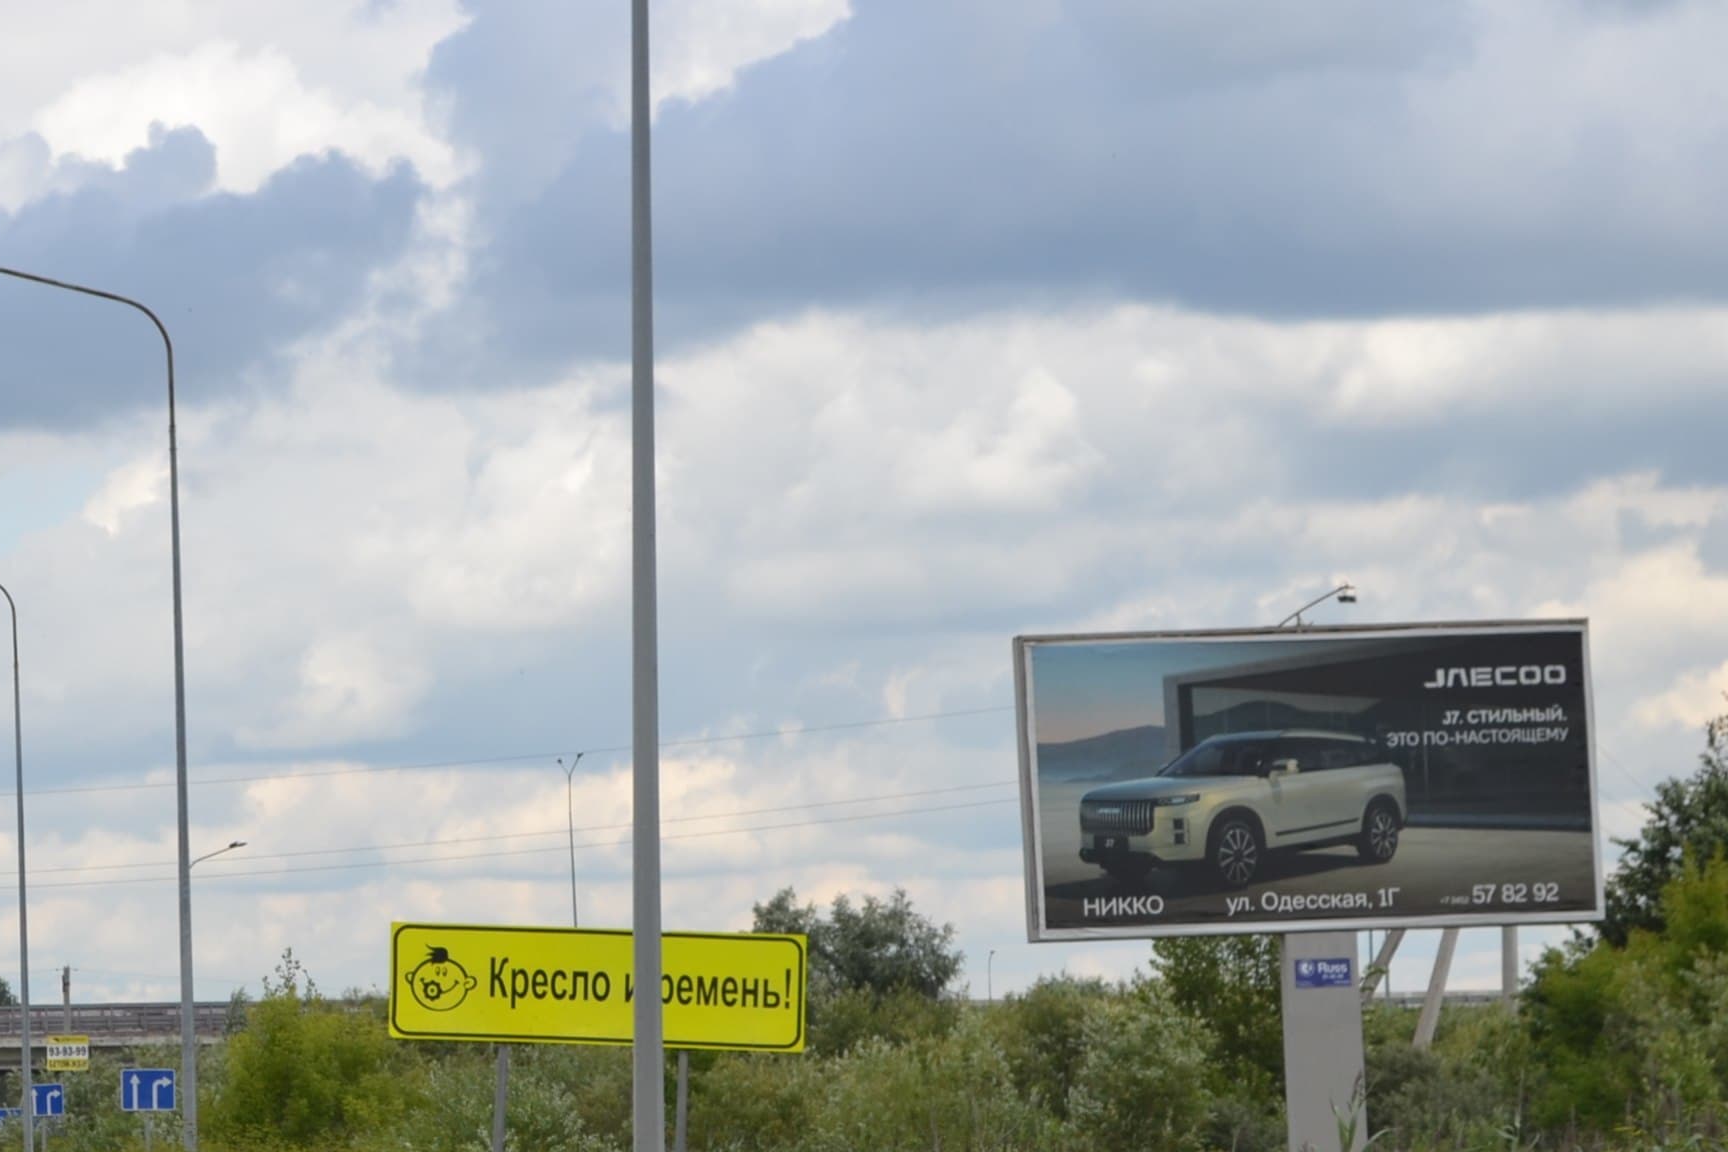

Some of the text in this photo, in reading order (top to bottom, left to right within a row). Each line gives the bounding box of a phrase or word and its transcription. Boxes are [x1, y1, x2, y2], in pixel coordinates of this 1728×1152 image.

[1467, 704, 1568, 724] СТИЛЬНЫЙ.
[1386, 727, 1569, 747] ЭТО ПО-НАСТОЯЩЕМУ
[1226, 887, 1400, 916] ул. Одесская, 1Г
[1472, 884, 1497, 905] 57
[1501, 883, 1528, 904] 82
[1532, 881, 1560, 903] 92
[1083, 895, 1164, 916] НИККО
[489, 956, 611, 1009] Кресло
